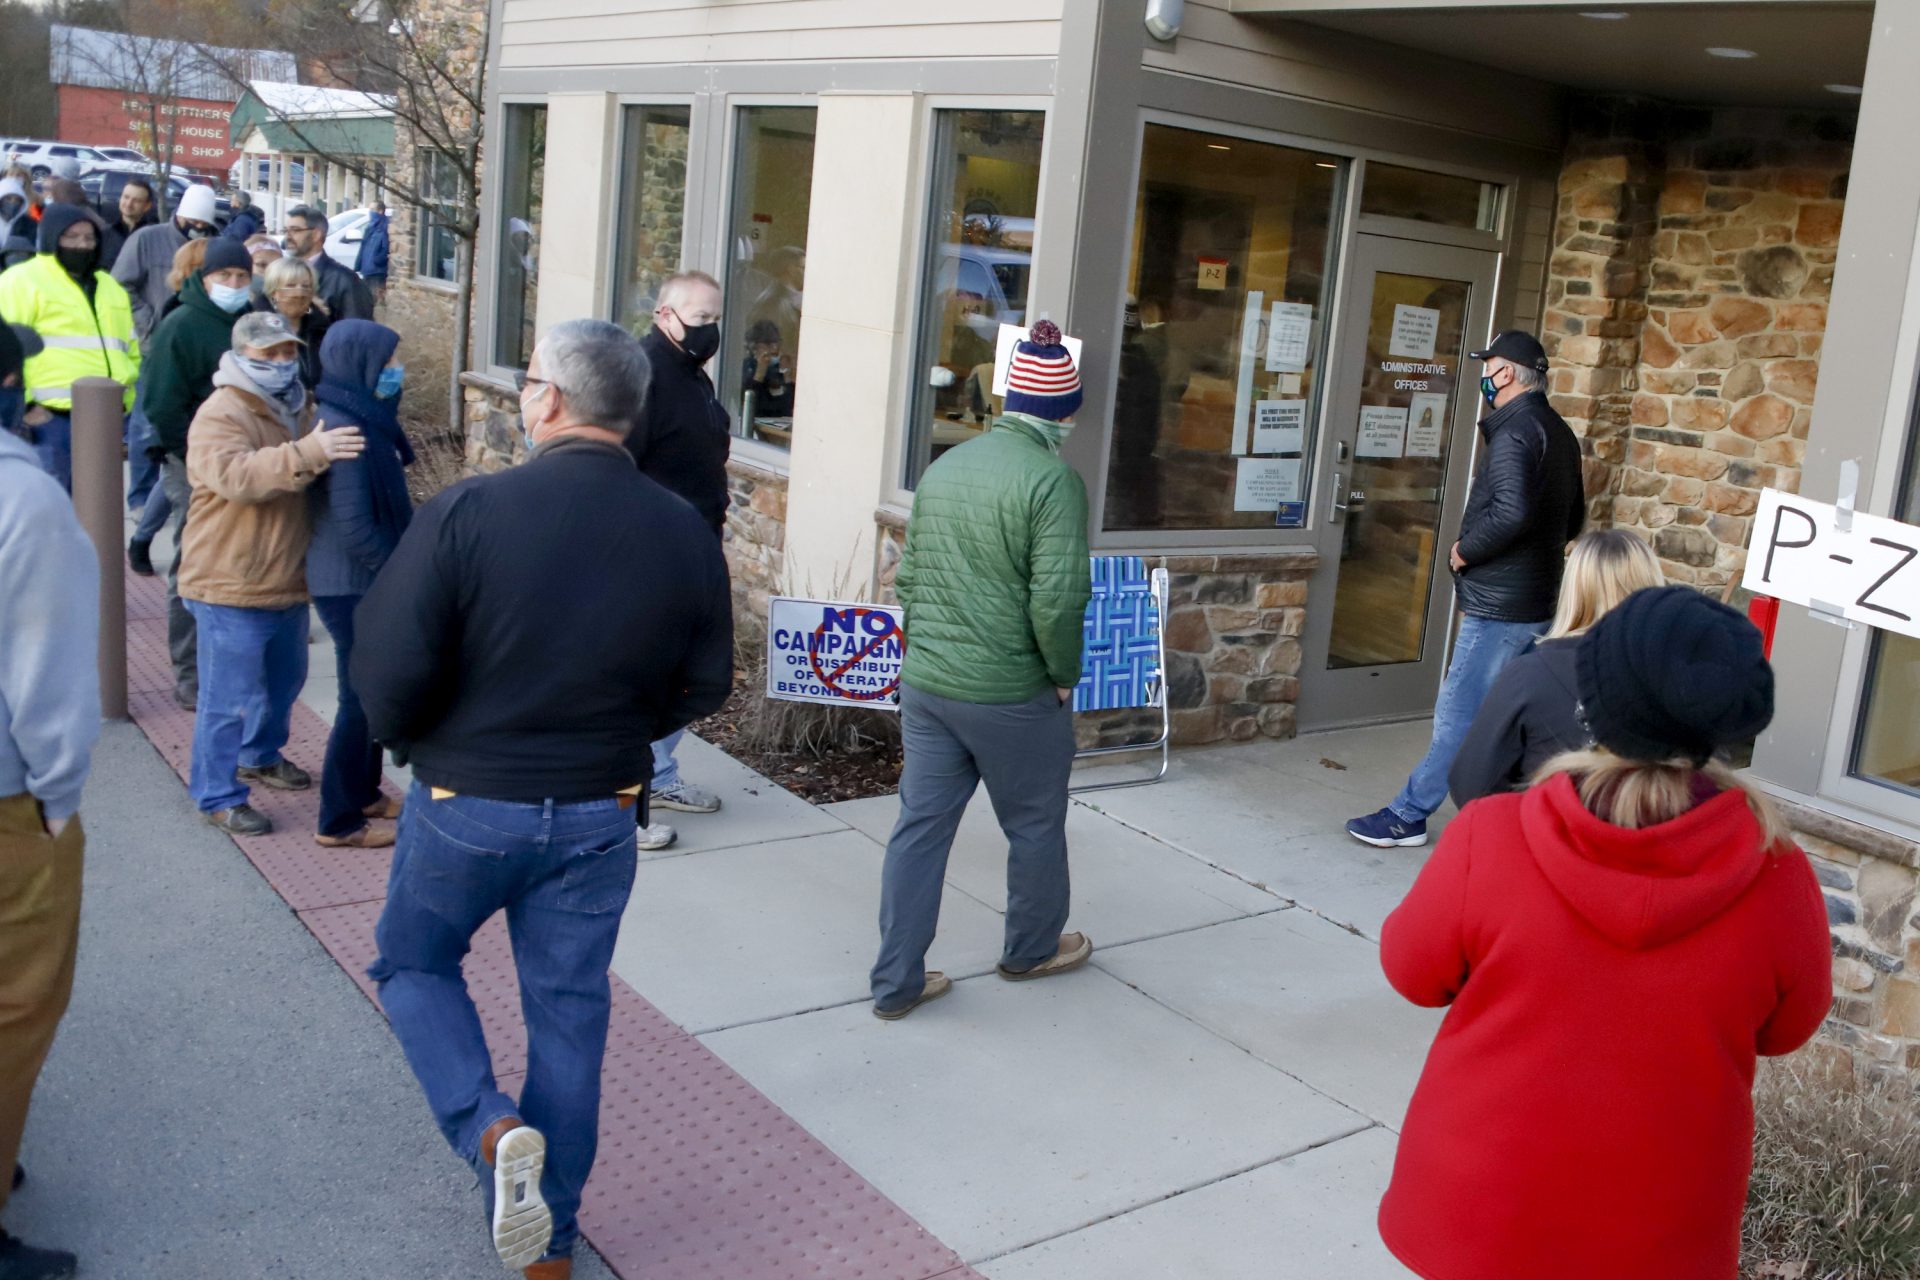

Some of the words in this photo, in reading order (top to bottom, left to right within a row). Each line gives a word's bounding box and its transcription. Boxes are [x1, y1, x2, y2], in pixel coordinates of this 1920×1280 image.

[180, 126, 224, 138] HOUSE
[191, 146, 225, 158] SHOP
[1206, 268, 1220, 279] P-Z
[1381, 361, 1446, 375] ADMINISTRATIVE
[1394, 379, 1428, 390] OFFICES
[1350, 491, 1366, 499] PULL
[1761, 504, 1919, 622] P-Z
[822, 606, 896, 636] NO
[774, 628, 902, 660] CAMPAIGN
[786, 654, 808, 666] OR
[794, 670, 815, 680] OF
[778, 681, 842, 697] BEYOND
